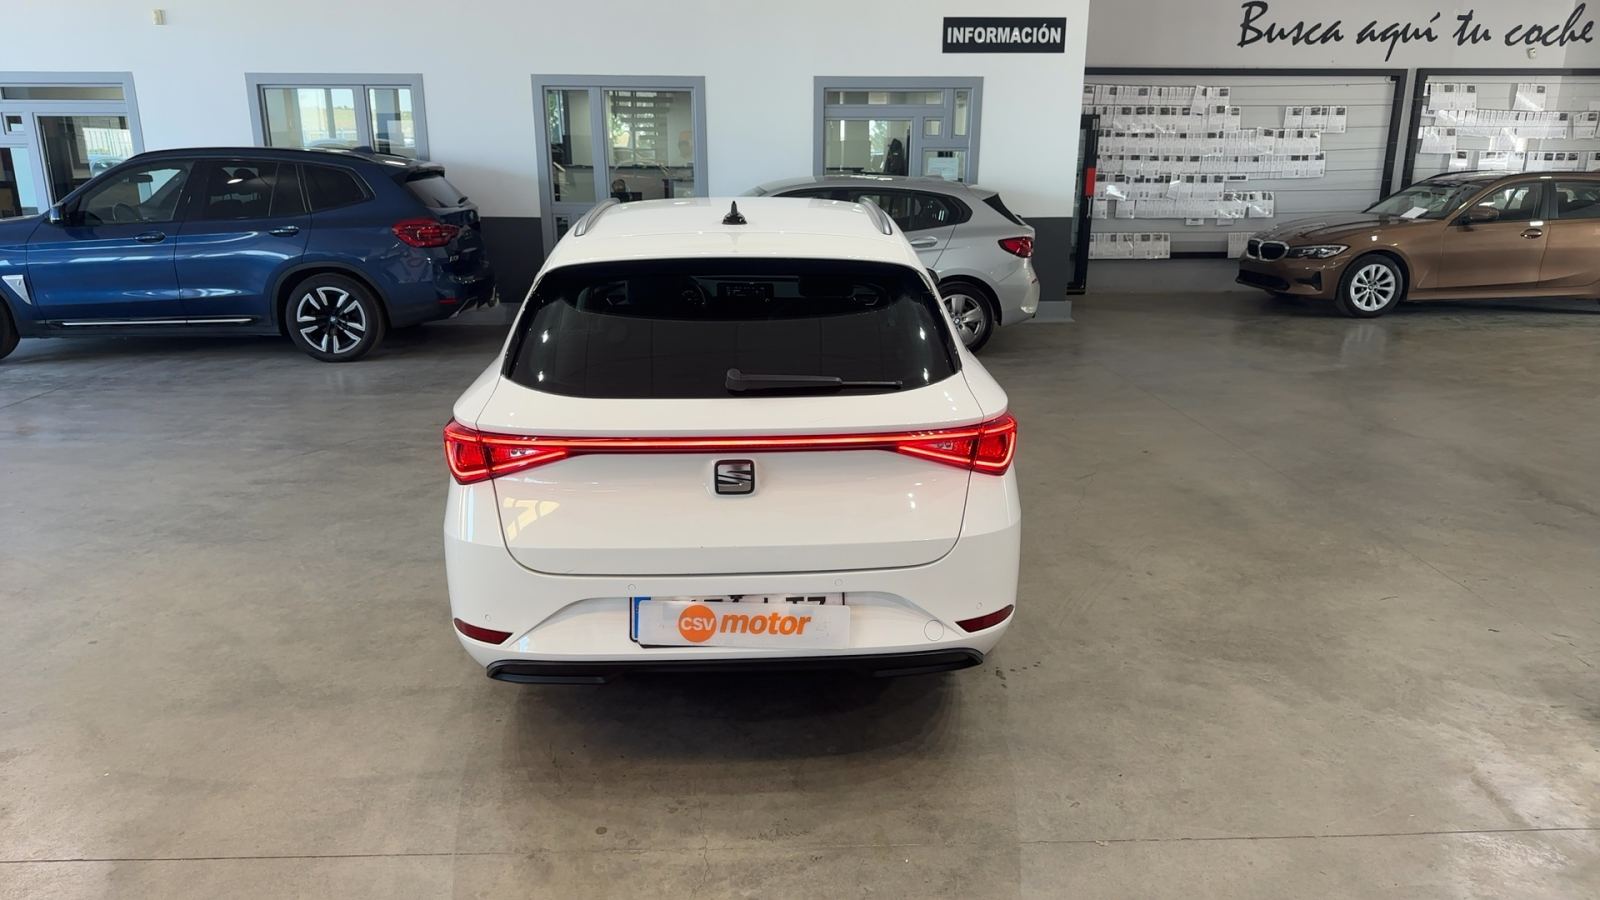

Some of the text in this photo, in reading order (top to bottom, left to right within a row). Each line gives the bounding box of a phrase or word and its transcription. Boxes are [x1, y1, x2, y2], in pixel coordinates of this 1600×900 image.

[946, 23, 1062, 44] INFORMACIÓN
[1236, 1, 1595, 62] Busca aquí tu coche
[680, 612, 811, 636] CSV motor
